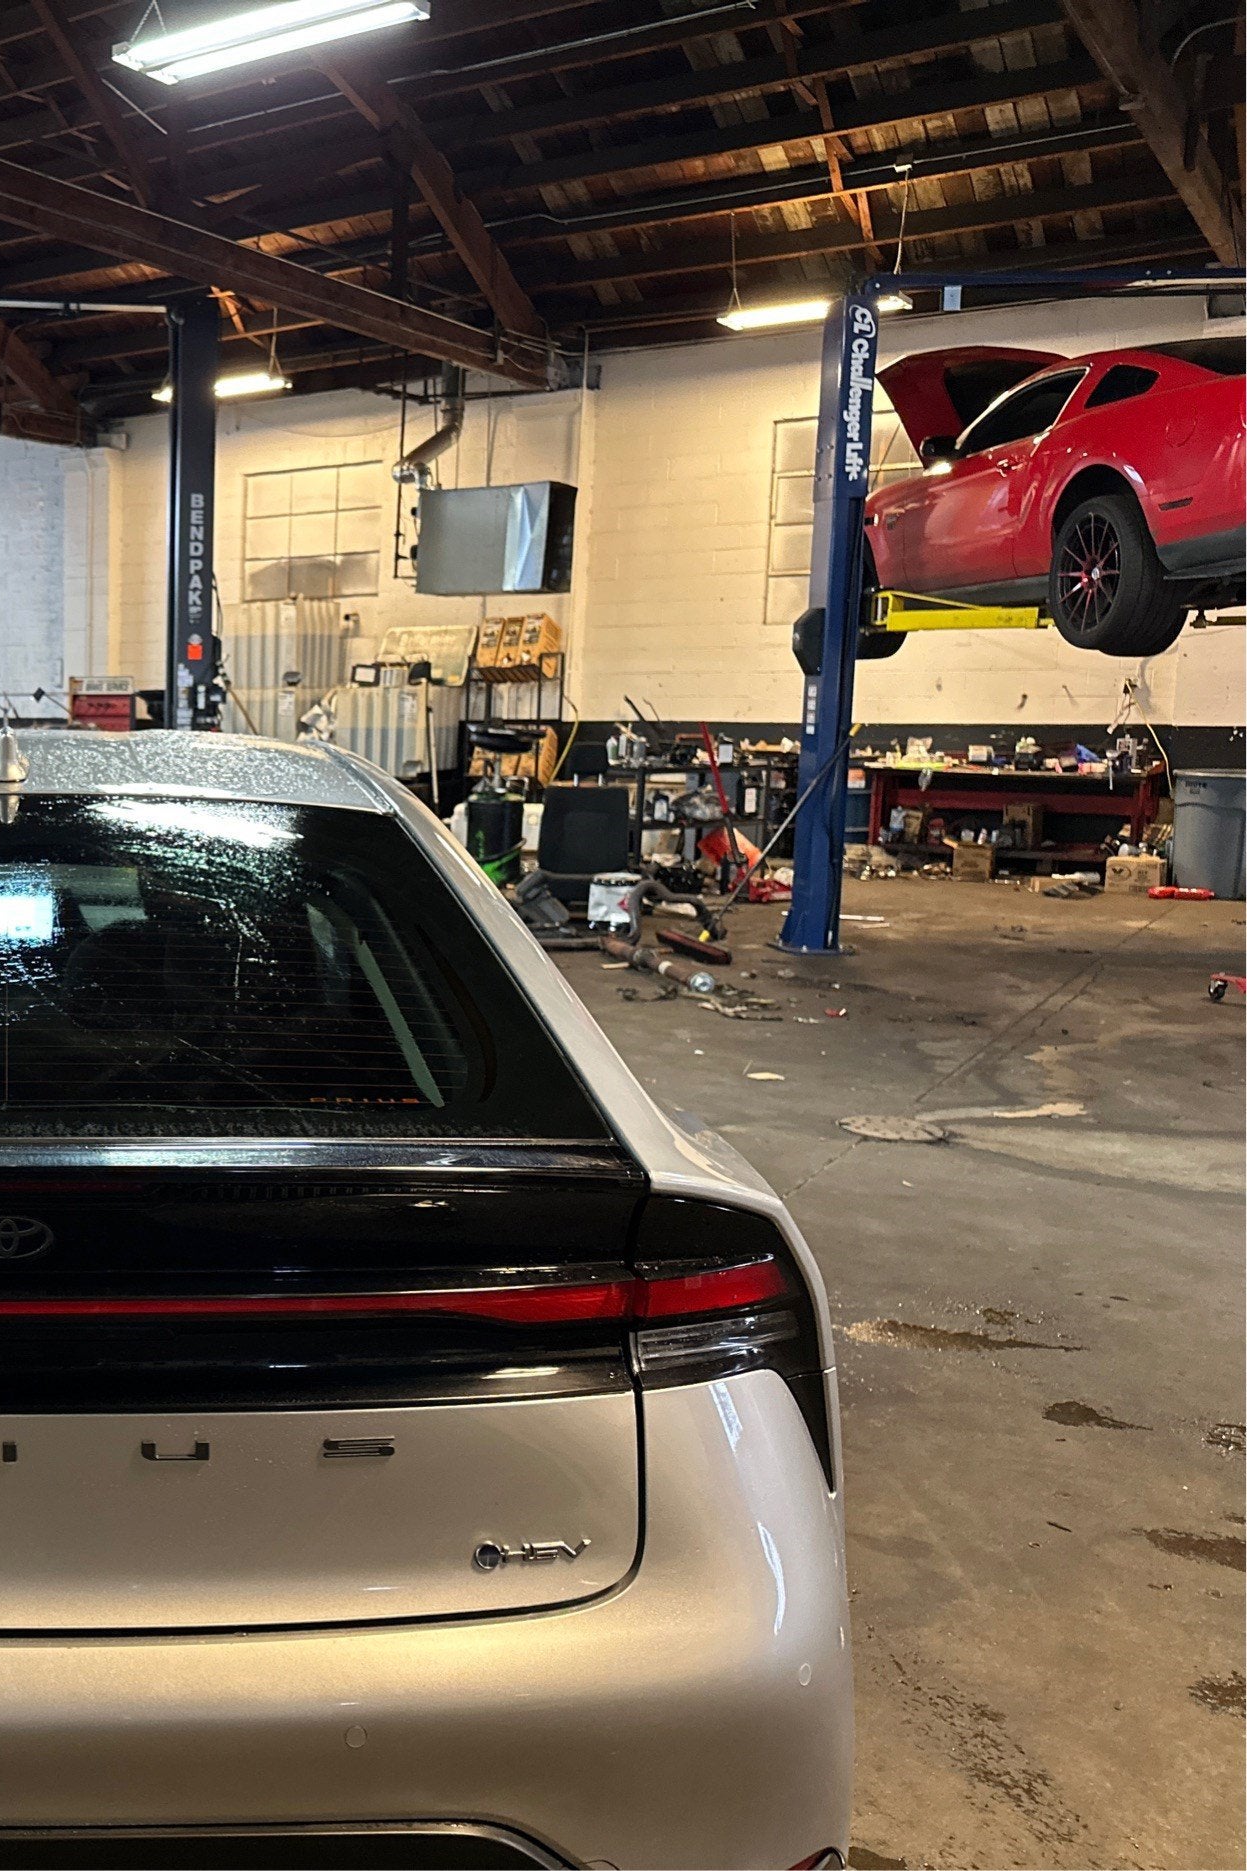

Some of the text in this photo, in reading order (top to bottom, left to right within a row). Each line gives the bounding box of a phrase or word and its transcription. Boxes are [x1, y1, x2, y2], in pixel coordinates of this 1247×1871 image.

[843, 338, 873, 441] Challenger
[845, 442, 864, 482] Lift
[188, 493, 205, 605] BENDPAK
[501, 1539, 591, 1562] HEV
